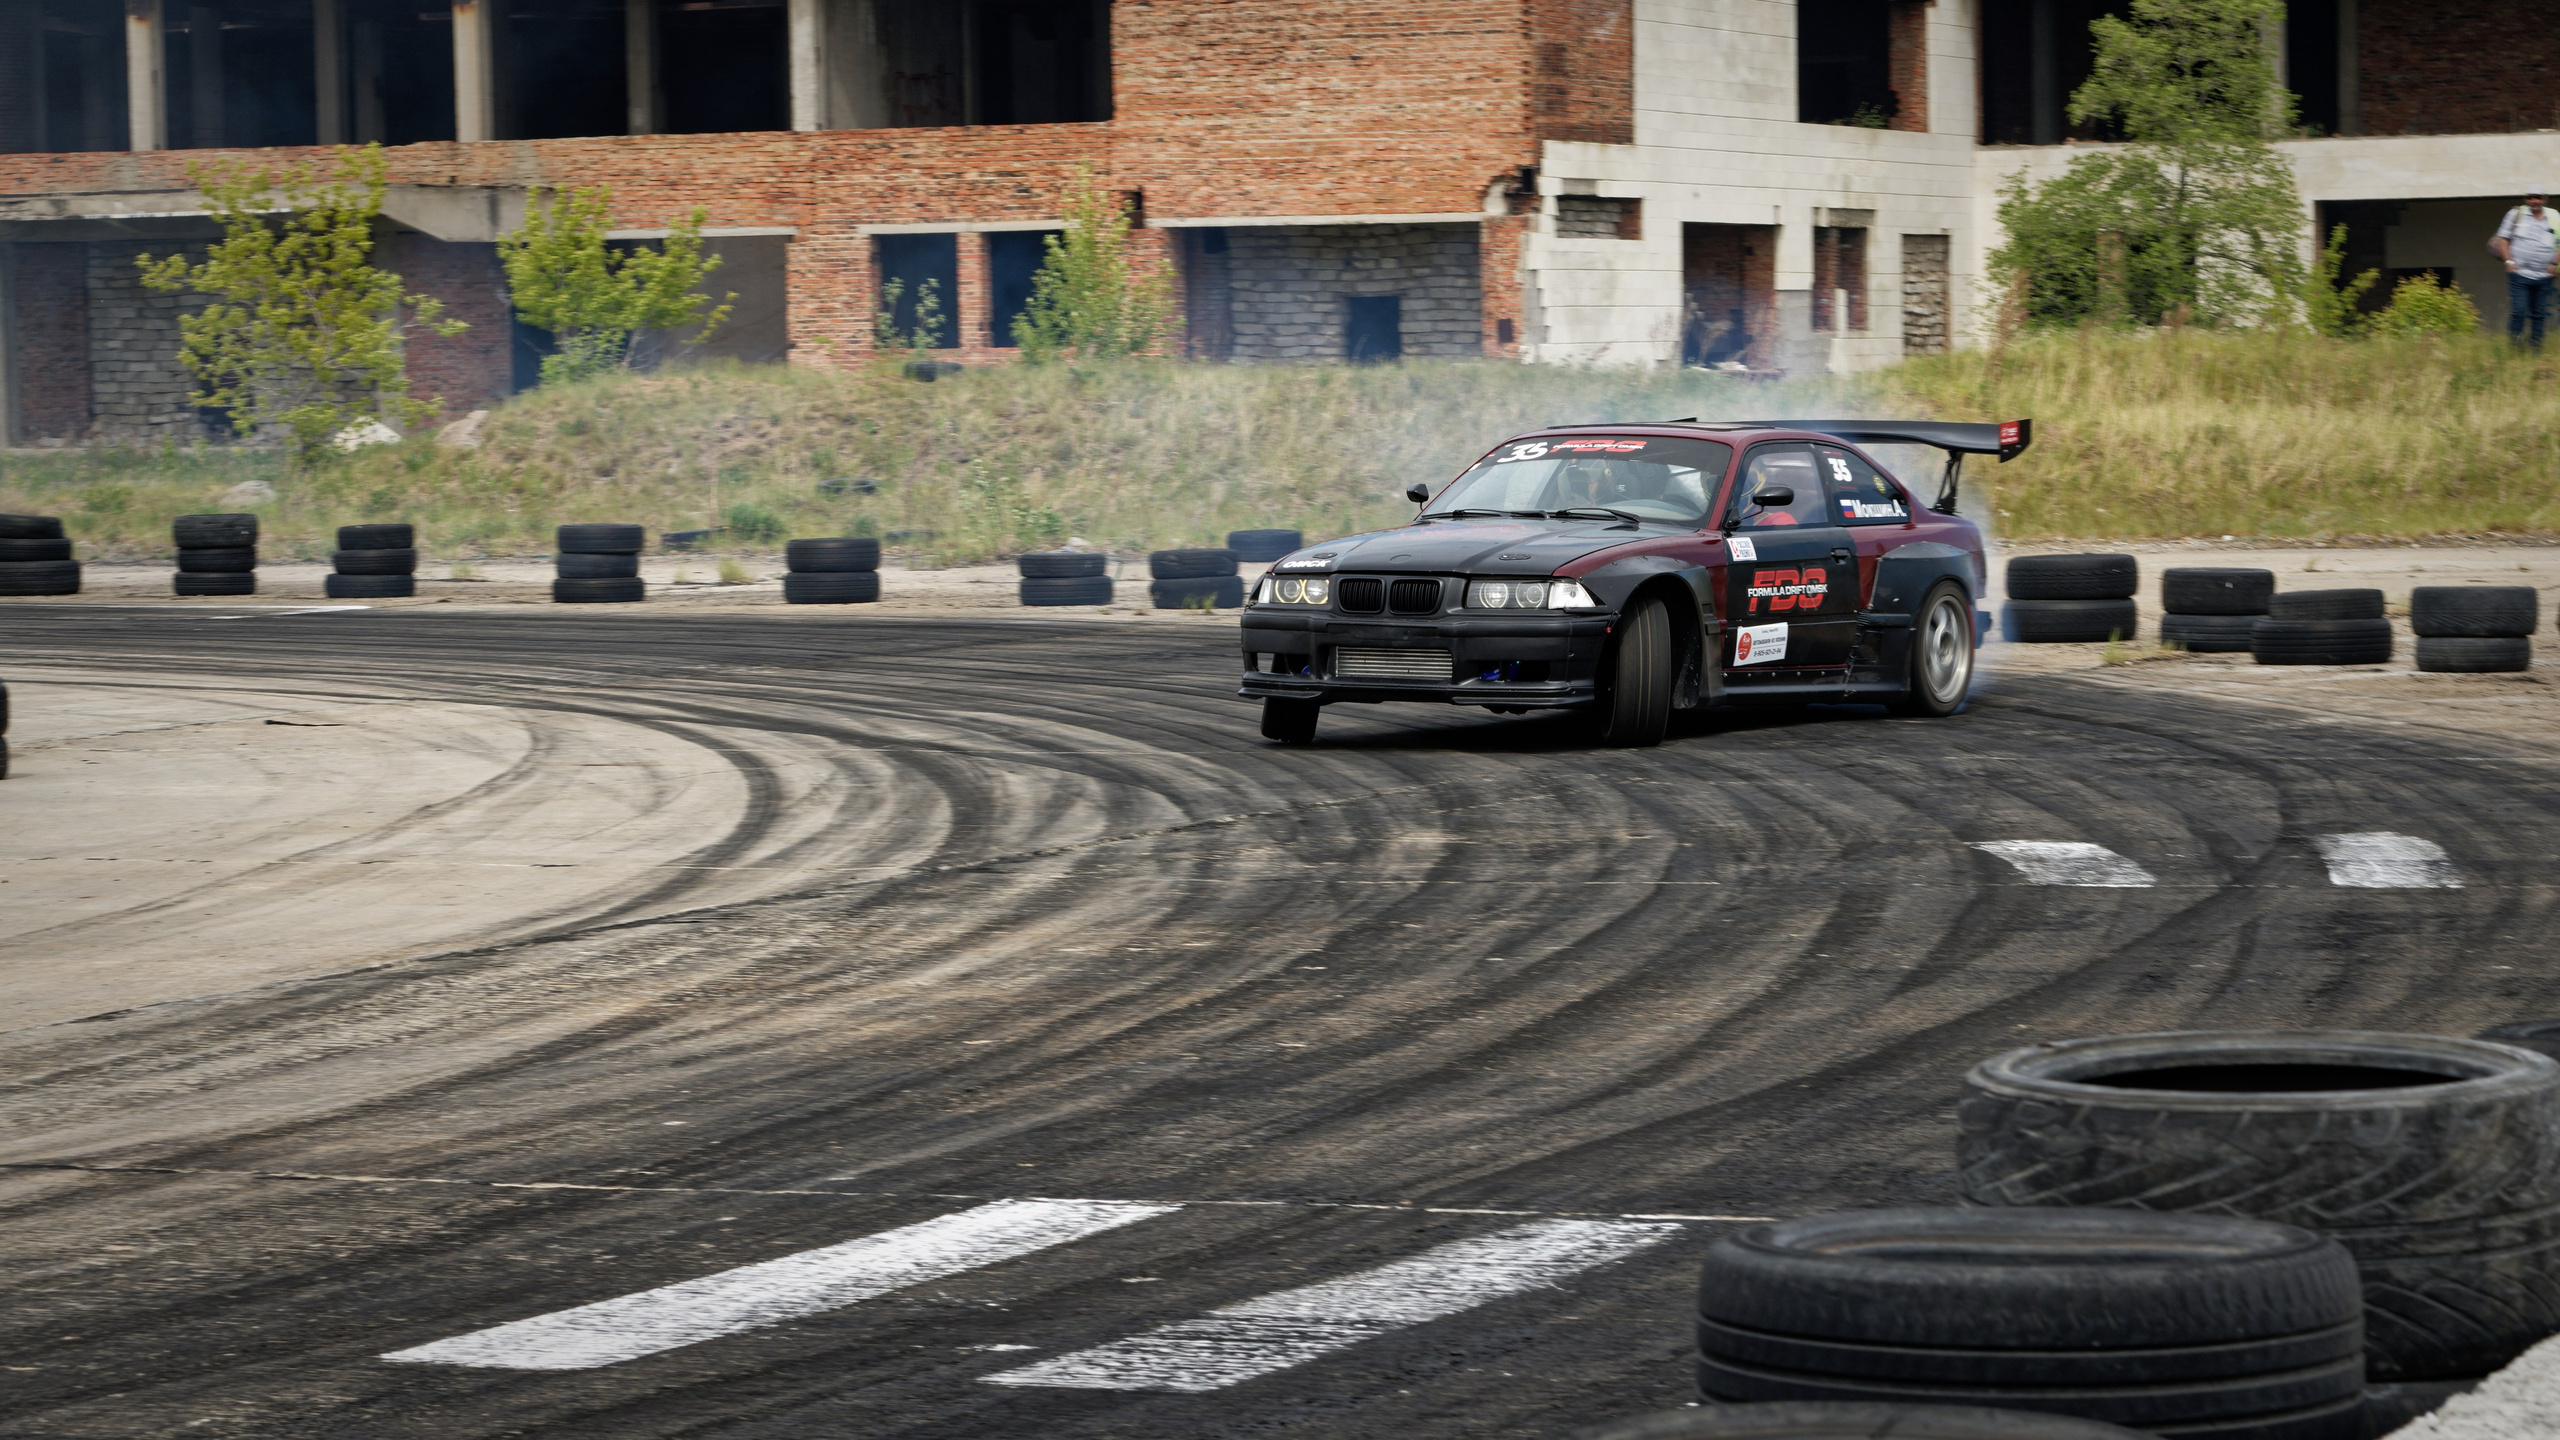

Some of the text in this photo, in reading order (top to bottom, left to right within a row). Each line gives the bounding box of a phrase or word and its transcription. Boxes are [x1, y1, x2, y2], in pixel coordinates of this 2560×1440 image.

[1497, 442, 1548, 462] 35
[1827, 458, 1853, 482] 35
[1748, 584, 1828, 597] FORMULA DRIFT OMSK
